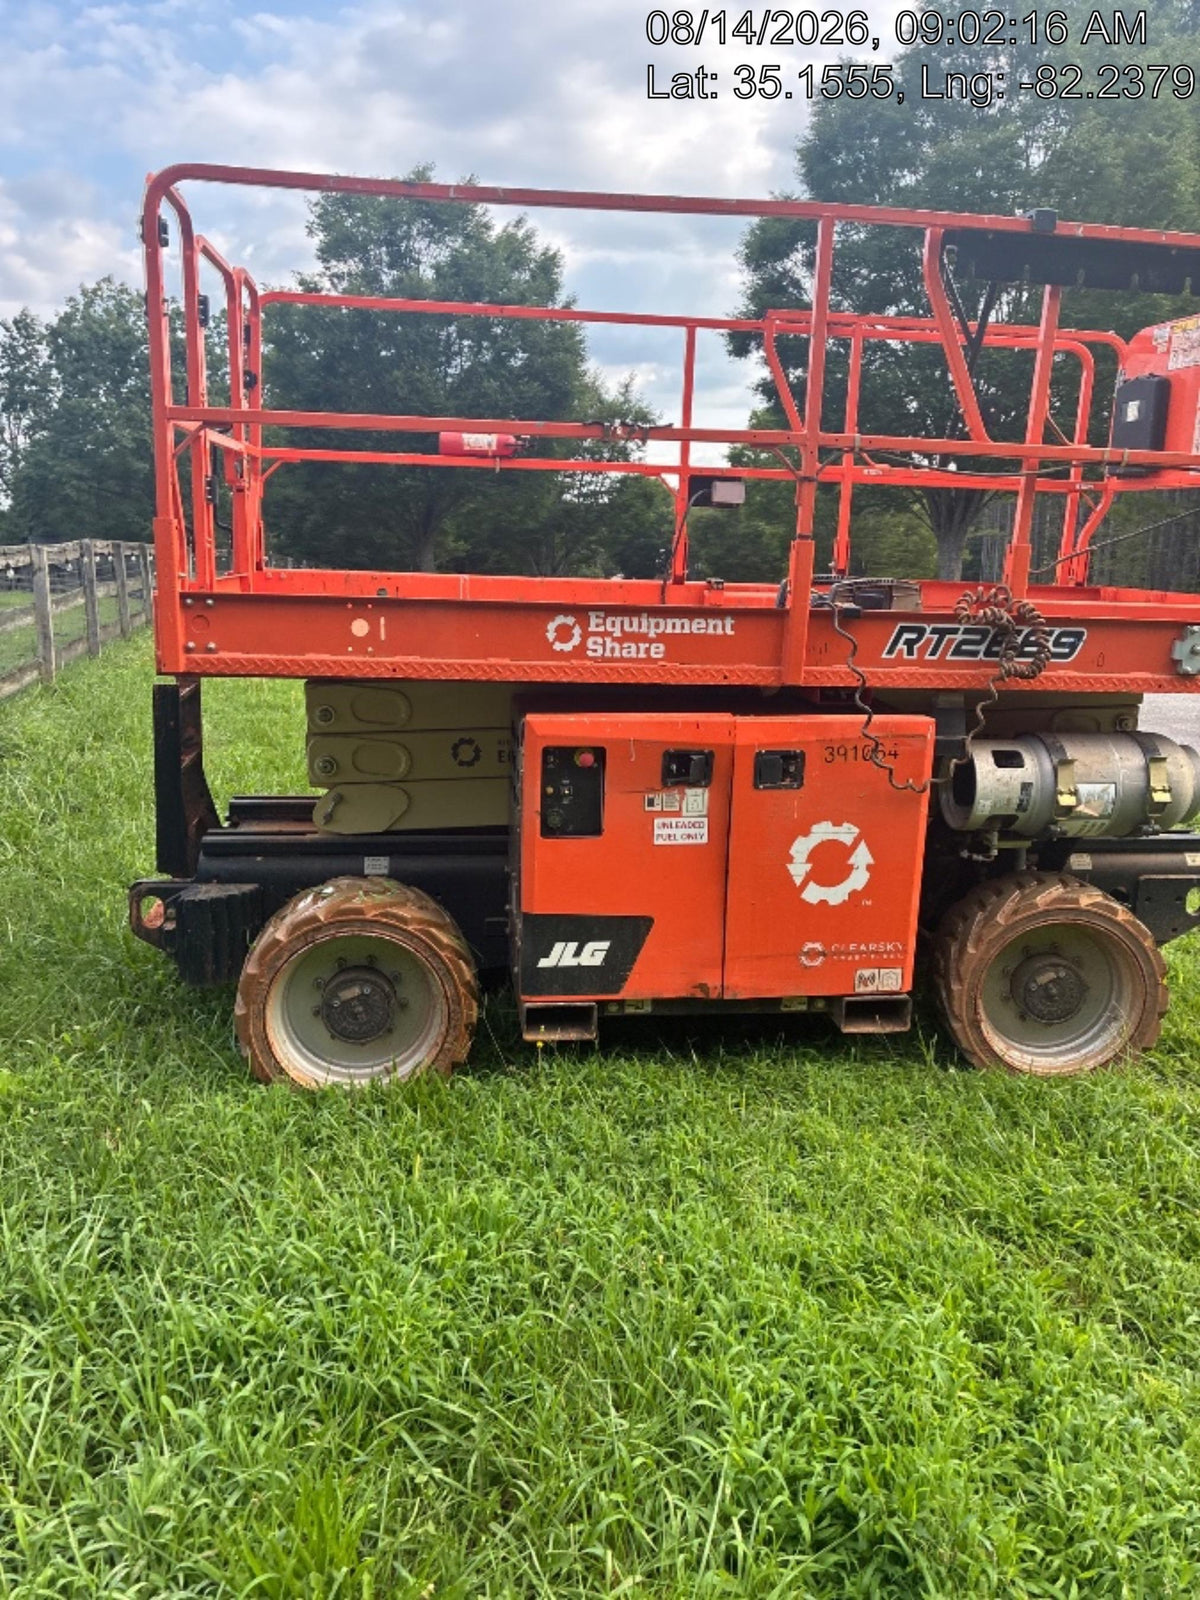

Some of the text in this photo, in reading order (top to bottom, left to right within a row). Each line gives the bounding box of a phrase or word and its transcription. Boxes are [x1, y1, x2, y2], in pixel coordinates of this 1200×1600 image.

[588, 611, 735, 637] Equipment
[586, 636, 665, 658] Share
[536, 941, 611, 968] JLG
